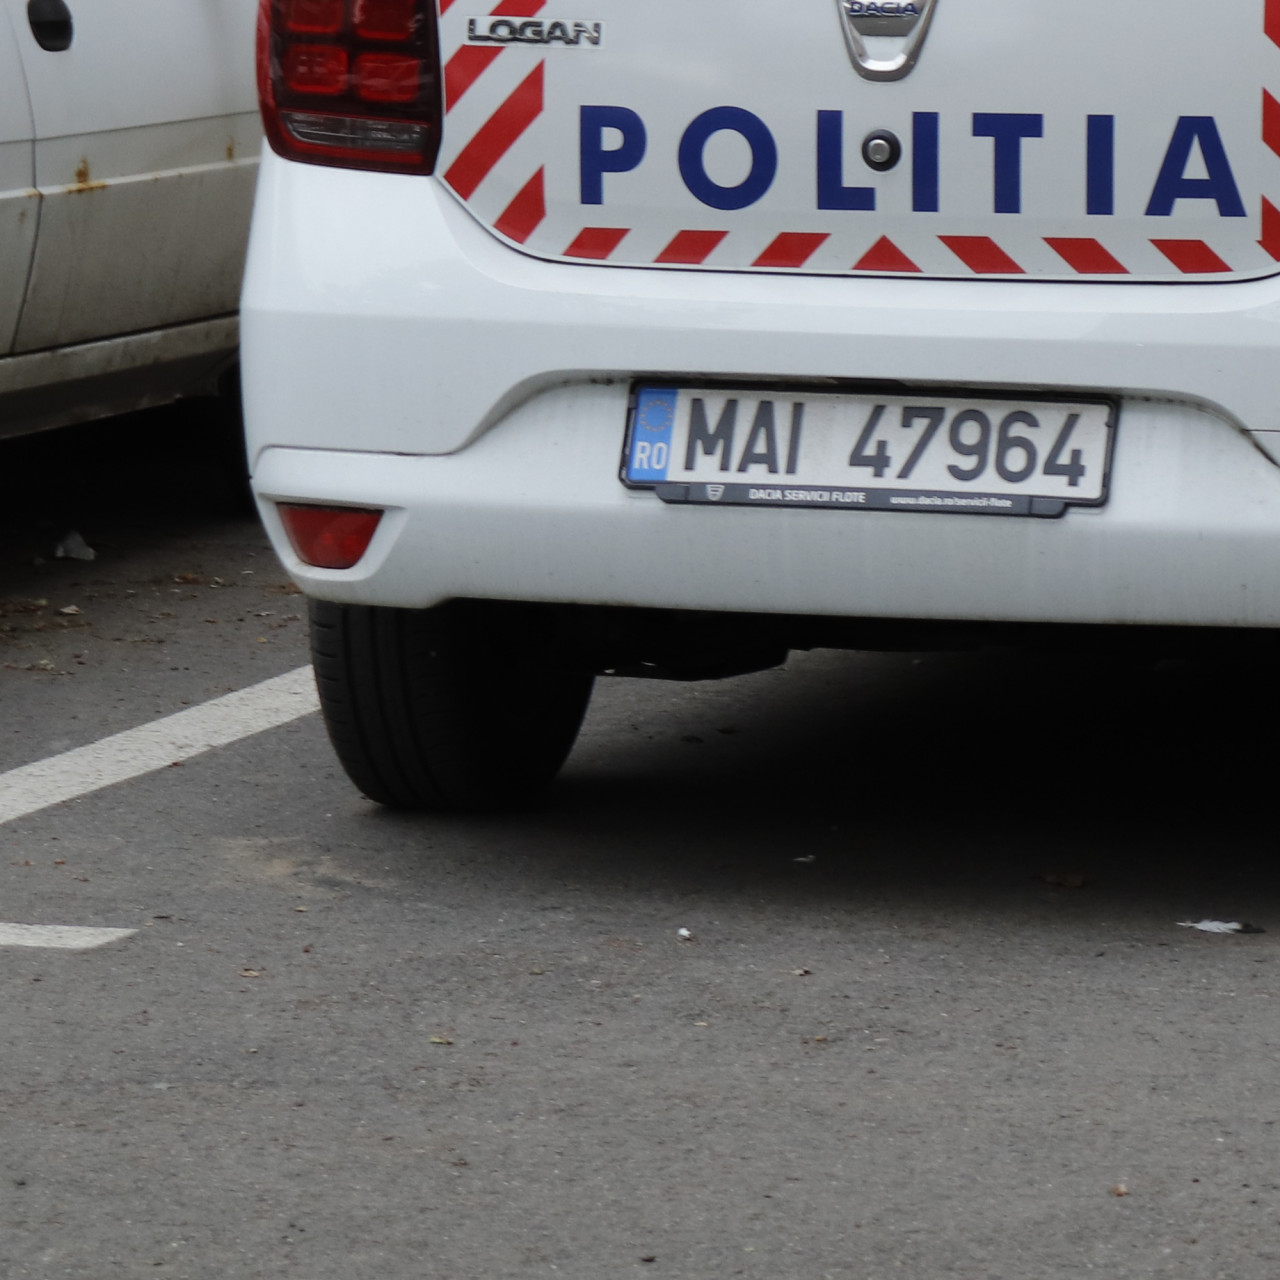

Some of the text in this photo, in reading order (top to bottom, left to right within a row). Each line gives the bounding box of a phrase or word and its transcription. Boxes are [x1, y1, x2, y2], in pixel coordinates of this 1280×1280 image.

[847, 1, 919, 17] DACIA
[468, 18, 602, 45] LOGAN
[578, 104, 1247, 218] POLITIA
[634, 441, 667, 470] RO
[683, 397, 1087, 487] MAI 47964
[748, 488, 867, 503] DACIA SERVICII FLOTE
